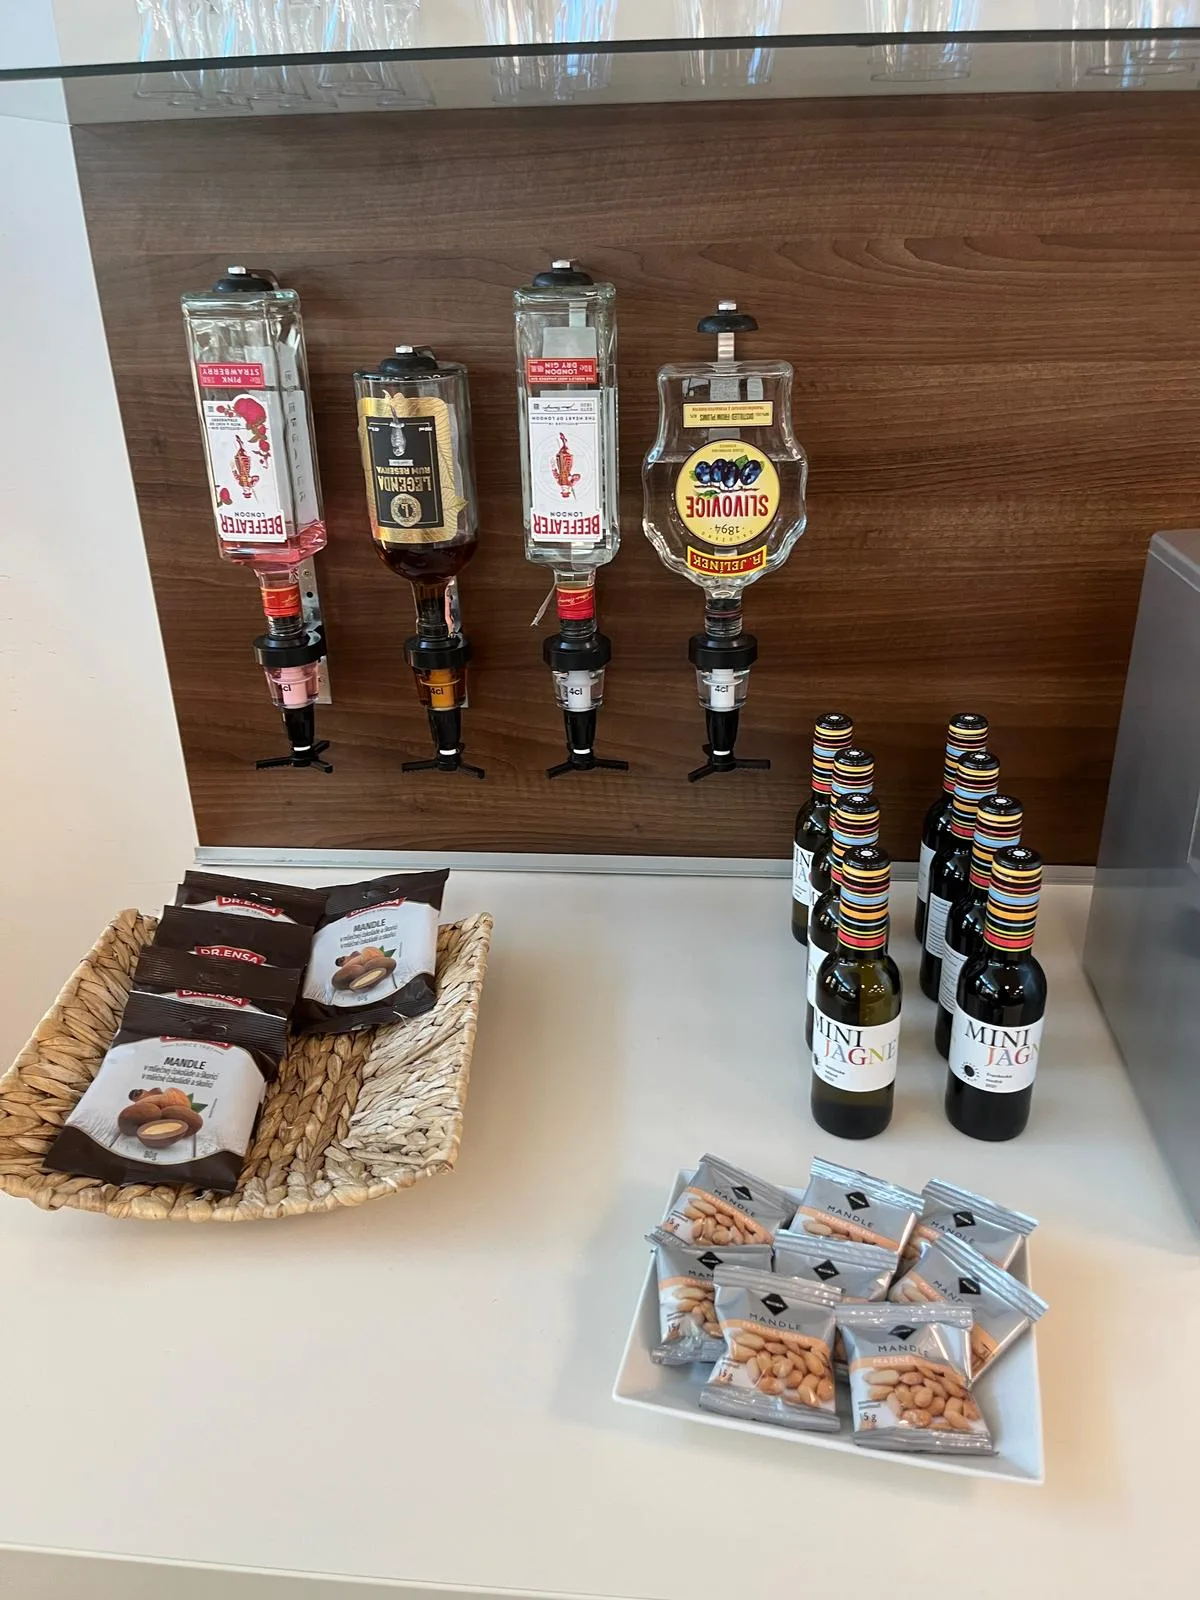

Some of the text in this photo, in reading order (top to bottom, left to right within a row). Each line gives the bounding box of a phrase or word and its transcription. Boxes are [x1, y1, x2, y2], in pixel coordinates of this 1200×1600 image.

[202, 368, 259, 376] STRAWBERRY
[375, 466, 431, 475] RUM RESERVA
[377, 475, 432, 492] LEGENDA
[401, 503, 409, 518] L
[685, 494, 769, 518] SLIVOVICE
[220, 513, 284, 534] BEEFEATER
[533, 513, 600, 535] BEEFEATER
[714, 524, 740, 536] 1894
[693, 554, 761, 572] R. JELÍNEK
[568, 687, 583, 696] 4cl
[714, 685, 729, 693] 4cl
[353, 918, 386, 932] MANDLE
[200, 948, 258, 964] DR.ENSA
[964, 1020, 1031, 1048] MINI
[164, 1057, 207, 1070] MANDLE
[714, 1189, 756, 1217] MANDLE
[827, 1205, 874, 1228] MANDLE
[750, 1312, 801, 1331] MANDLE
[878, 1344, 928, 1359] MANDLE
